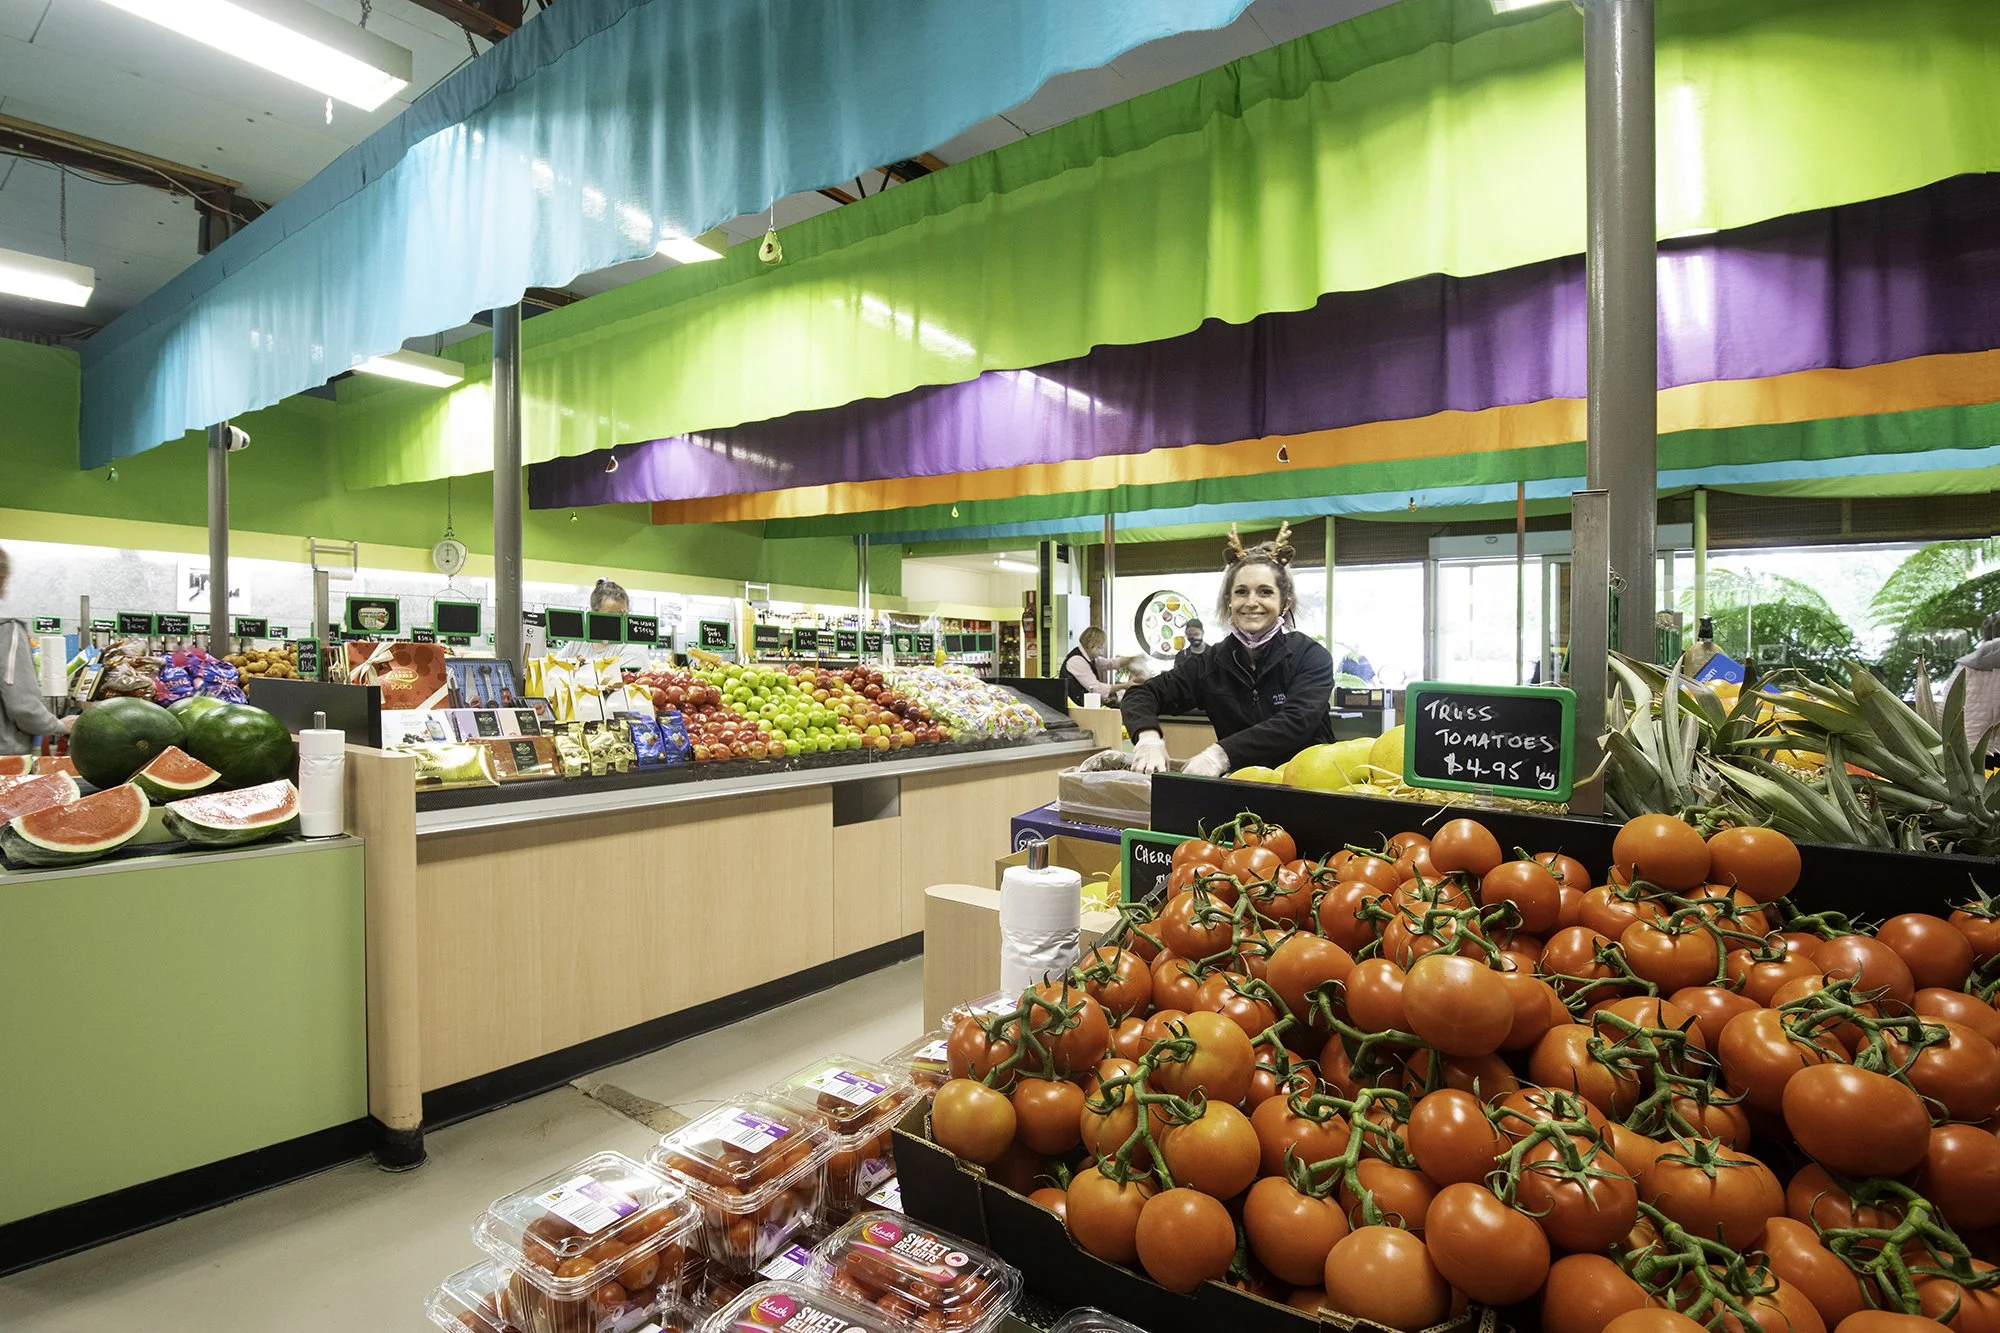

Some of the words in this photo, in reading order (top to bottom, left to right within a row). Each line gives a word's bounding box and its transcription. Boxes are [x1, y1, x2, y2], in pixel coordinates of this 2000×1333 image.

[1424, 699, 1493, 722] TRUSS
[1435, 728, 1554, 754] TOMATOES
[1135, 844, 1173, 866] CHERR
[869, 1223, 896, 1241] blush
[894, 1241, 939, 1264] DELIGHTS
[902, 1232, 951, 1256] SWEET
[759, 1297, 789, 1318] blush
[795, 1306, 849, 1333] SWEET
